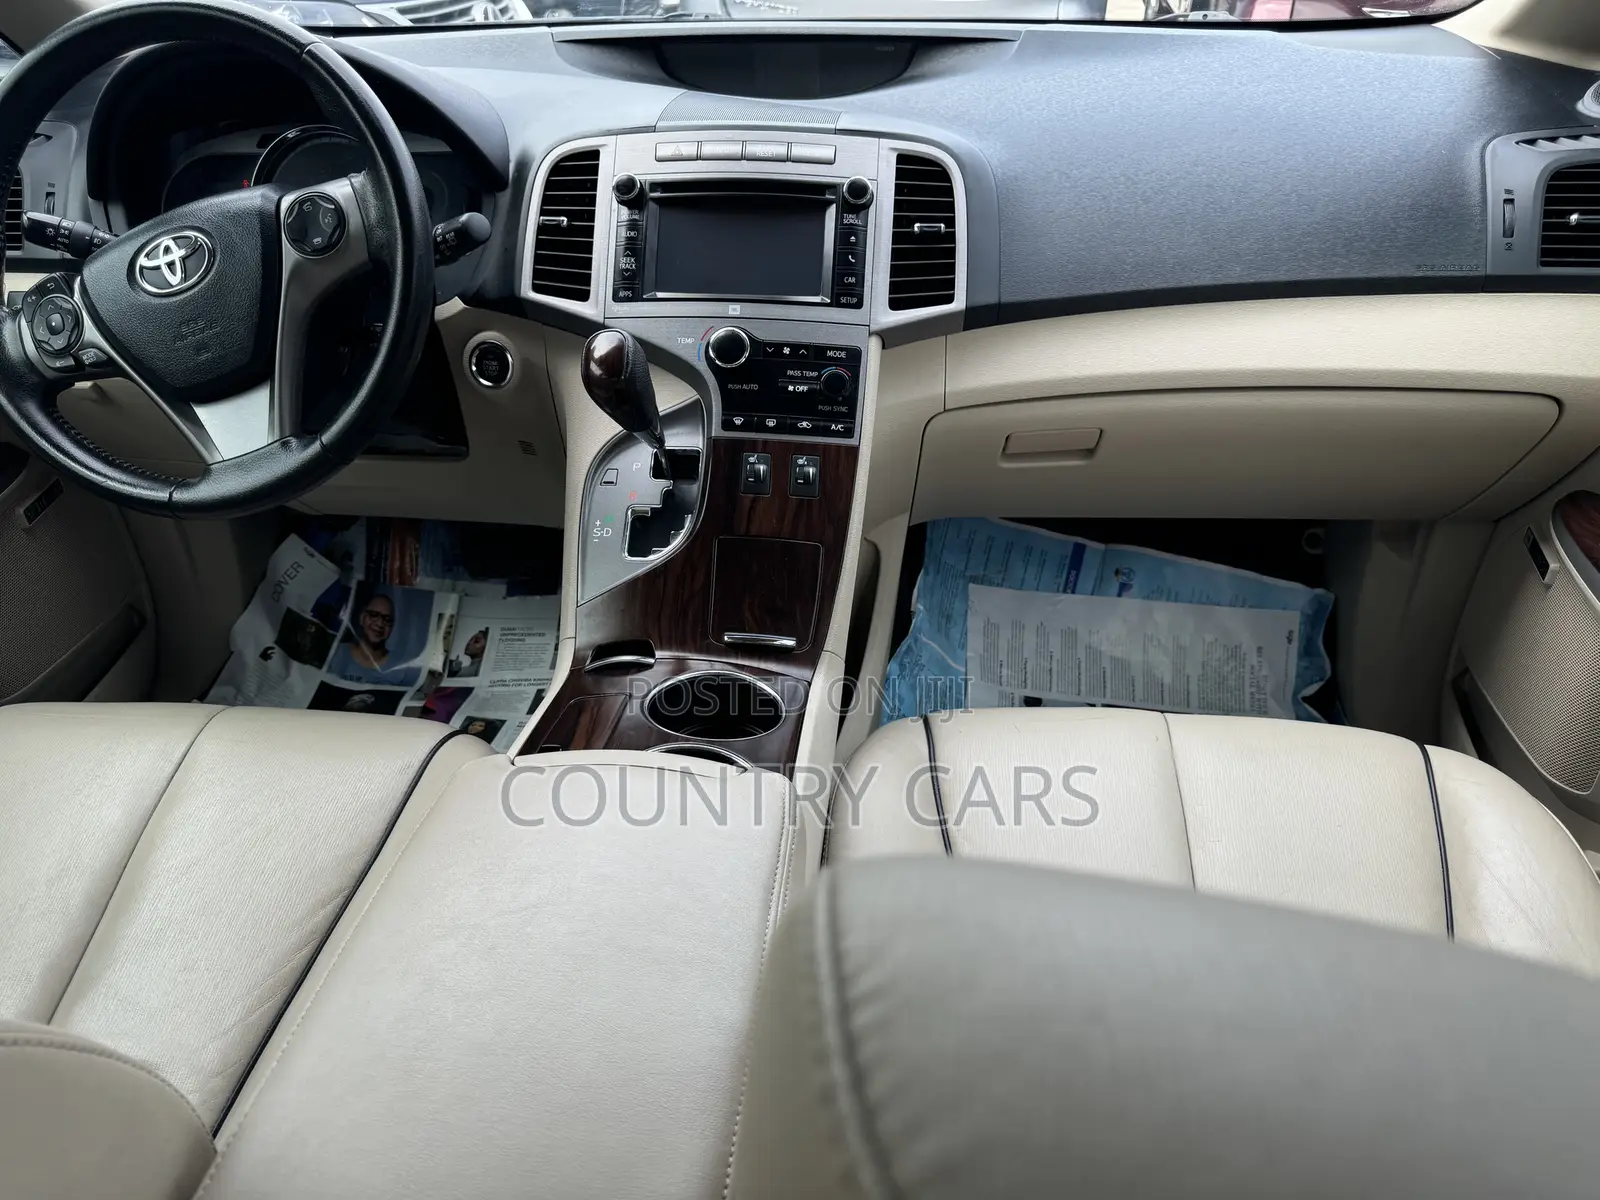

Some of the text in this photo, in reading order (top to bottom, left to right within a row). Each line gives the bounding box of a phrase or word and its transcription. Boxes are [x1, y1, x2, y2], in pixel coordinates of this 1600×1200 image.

[618, 290, 633, 298] APPS
[840, 296, 858, 304] SETUP
[827, 350, 847, 358] MODE
[795, 385, 809, 393] OFF
[830, 424, 845, 432] A/C
[632, 462, 641, 471] P
[270, 560, 305, 601] COVER
